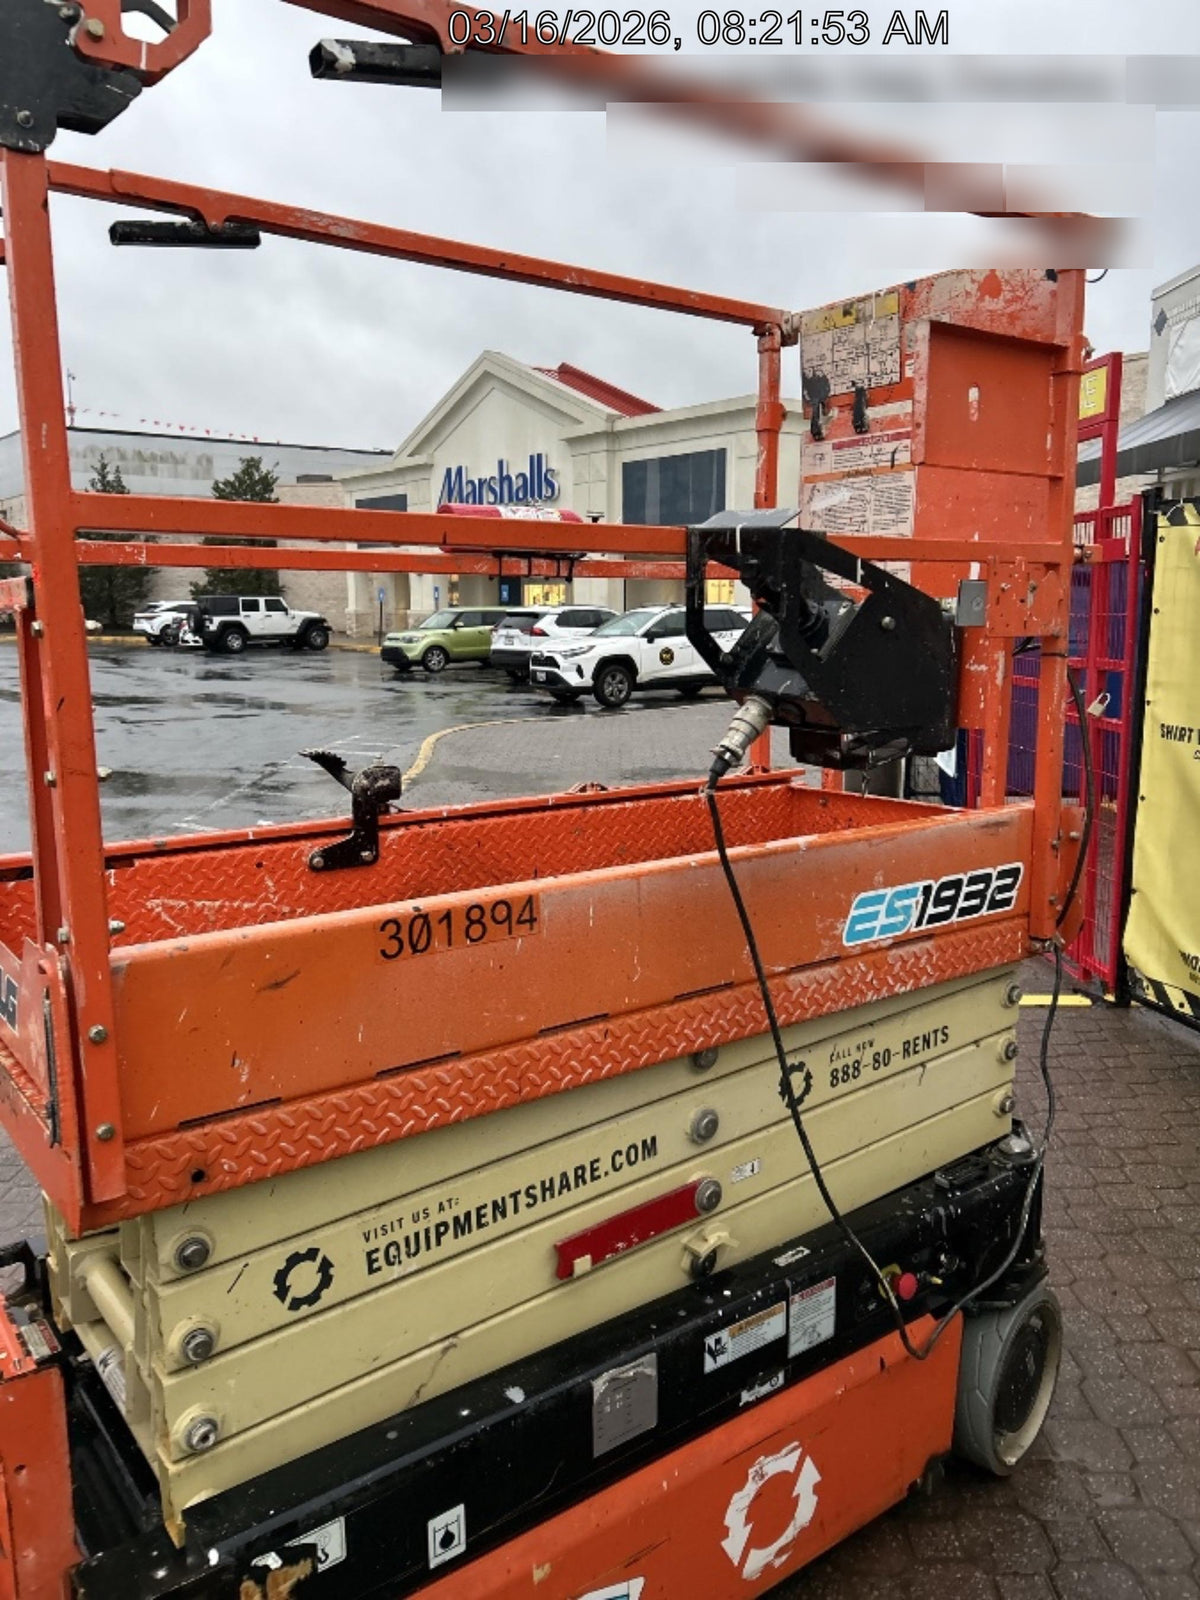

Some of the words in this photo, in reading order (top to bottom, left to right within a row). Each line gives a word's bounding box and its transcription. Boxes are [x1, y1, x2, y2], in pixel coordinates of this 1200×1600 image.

[437, 453, 557, 506] Marshalls
[1160, 723, 1194, 743] SHIRT
[379, 894, 538, 960] 301894
[843, 862, 1024, 946] ES1932
[829, 1025, 949, 1088] 888-80-RENTS
[362, 1218, 404, 1243] VISIT
[411, 1208, 430, 1224] US
[365, 1135, 658, 1275] EQUIPMENTSHARE.COM
